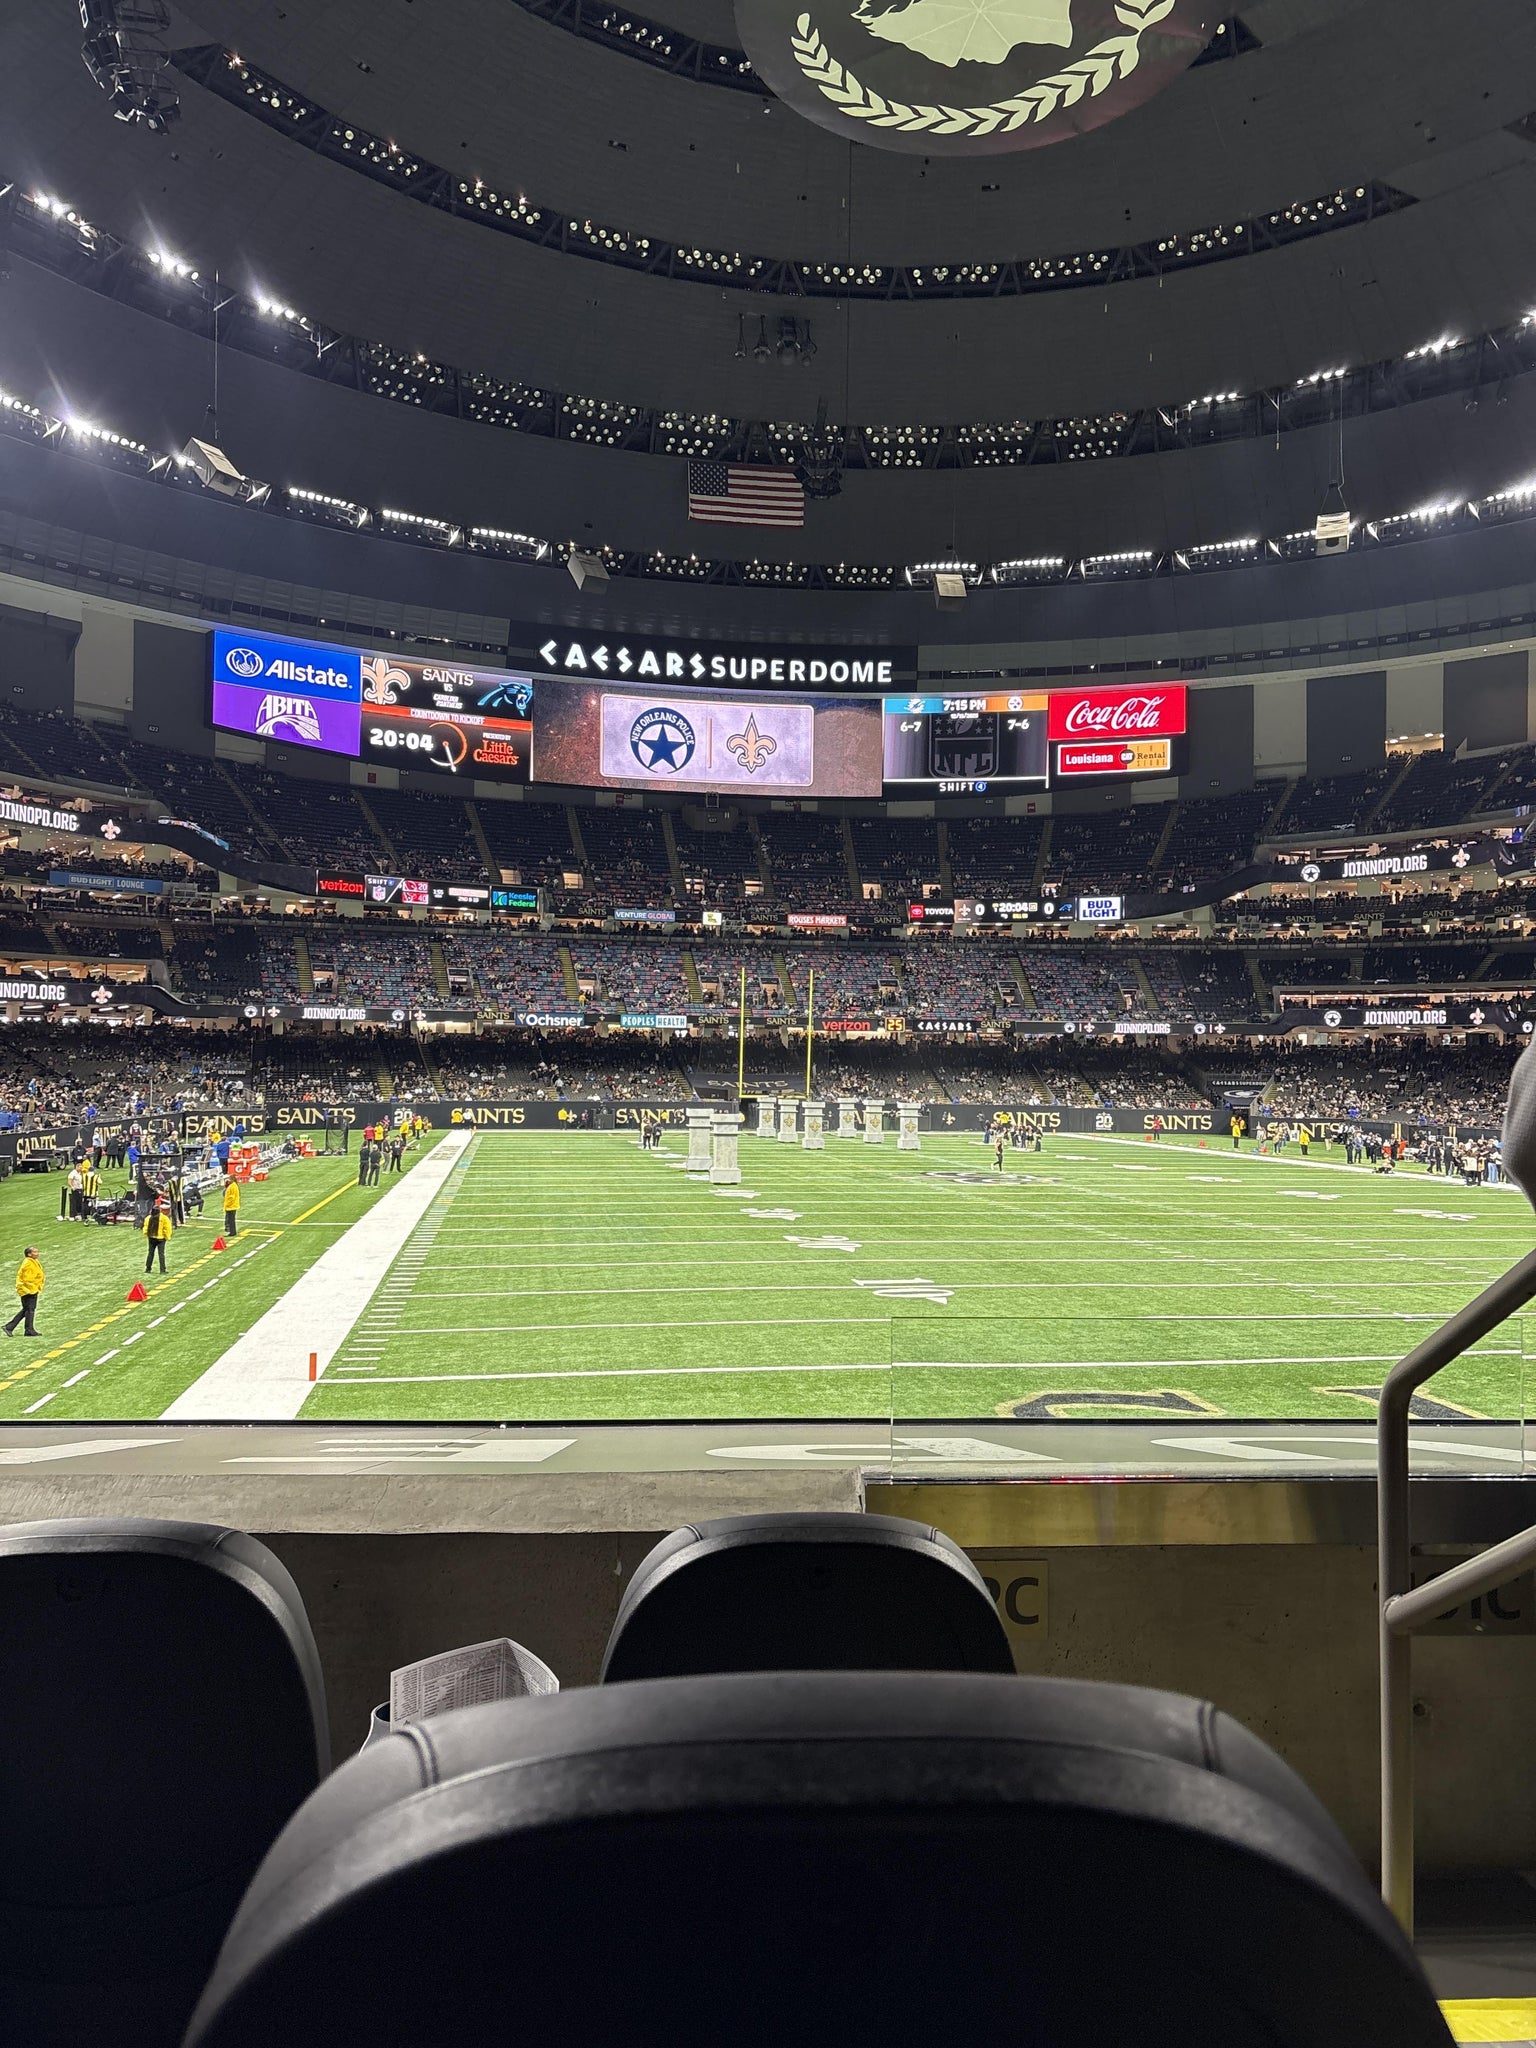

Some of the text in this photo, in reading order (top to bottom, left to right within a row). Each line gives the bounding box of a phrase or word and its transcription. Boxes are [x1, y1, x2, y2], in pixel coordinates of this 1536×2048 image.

[539, 640, 893, 683] CAESARS SUPERDOME
[265, 659, 348, 689] Allstate
[422, 668, 474, 686] SAINTS
[257, 694, 318, 724] ABITA
[943, 699, 987, 711] 7:15 PM
[410, 708, 485, 725] COUNTDOWN TO KICKOFF
[1066, 696, 1166, 732] Coca-Cola
[631, 712, 694, 746] NEW ORLEANS POLICE
[900, 722, 922, 732] 6-7
[1007, 719, 1030, 730] 7-6
[370, 728, 434, 751] 20:04
[482, 740, 514, 755] Little
[473, 748, 520, 765] Caesars
[1065, 751, 1166, 765] Louisiana CAT Rental
[1342, 855, 1428, 879] JOINNOPD.ORG
[70, 875, 145, 890] BUD LIGHT LOUNGE
[319, 879, 364, 894] verizon
[508, 891, 537, 901] Keesler
[508, 899, 536, 908] Federal
[998, 902, 1029, 912] 20:04
[1087, 900, 1113, 909] BUD
[1494, 904, 1527, 914] SAINTS
[578, 907, 607, 915] SAINTS
[615, 911, 674, 921] VENTURE GLOBAL
[924, 907, 954, 916] TOYOTA
[1082, 908, 1117, 918] LIGHT
[1354, 912, 1385, 921] SAINTS
[1422, 909, 1455, 918] SAINTS
[750, 914, 779, 922] SAINTS
[788, 914, 847, 925] ROUSES MARKETS
[1285, 915, 1317, 923] SAINTS
[301, 1007, 366, 1020] JOINNOPD.ORG
[476, 1011, 510, 1020] SAINTS
[1363, 1009, 1447, 1025] JOINNOPD.ORG
[525, 1013, 583, 1027] Ochsner
[622, 1015, 686, 1028] PEOPLES HEALTH
[698, 1016, 729, 1025] SAINTS
[766, 1017, 798, 1026] SAINTS
[822, 1019, 871, 1032] verizon
[887, 1019, 902, 1030] 25
[980, 1020, 1012, 1029] SAINTS
[917, 1021, 972, 1032] CAESARS
[1113, 1022, 1171, 1034] JOINNOPD.ORG
[707, 1079, 789, 1089] SAINTS
[277, 1107, 356, 1125] SAINTS
[186, 1115, 265, 1134] SAINTS
[1143, 1114, 1213, 1131] SAINTS
